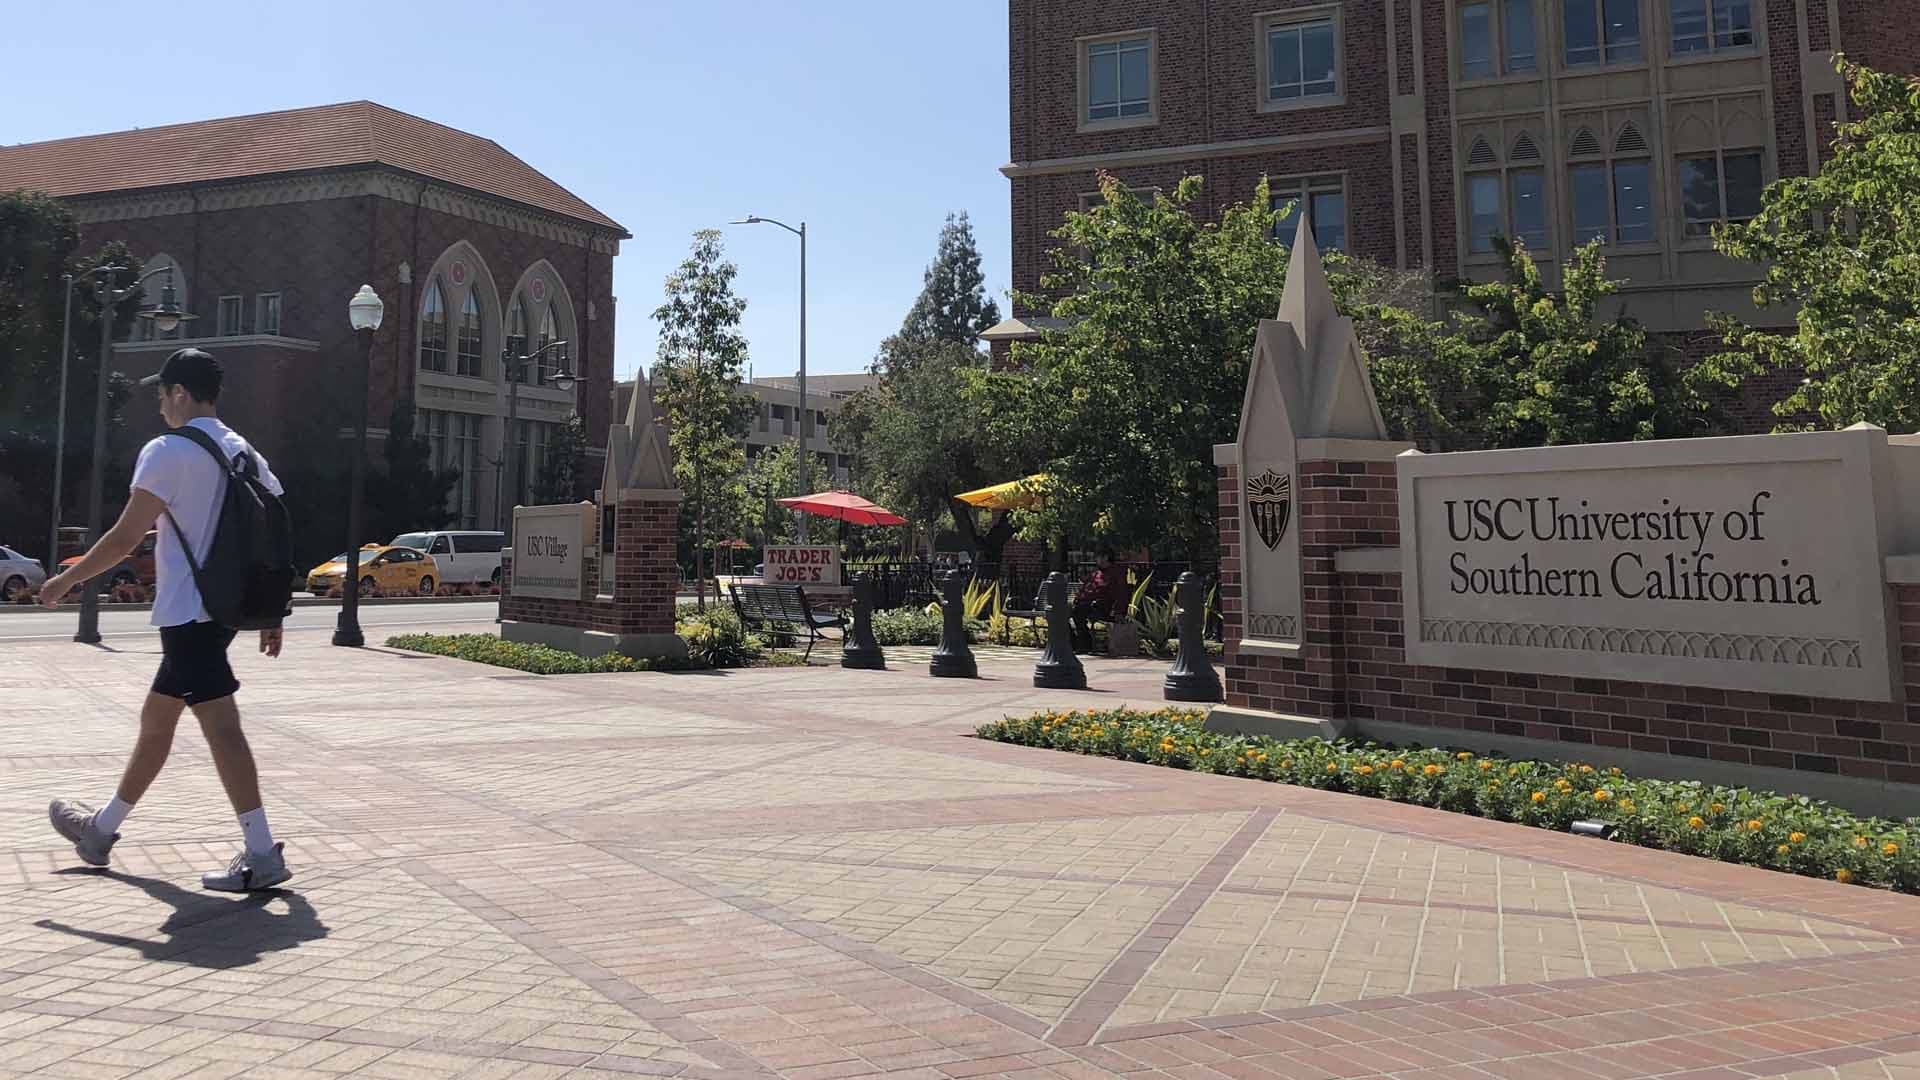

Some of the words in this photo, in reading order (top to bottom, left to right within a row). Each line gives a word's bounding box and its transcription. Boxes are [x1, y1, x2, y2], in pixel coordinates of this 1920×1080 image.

[1444, 497, 1524, 542] USC
[1527, 496, 1714, 556] University
[1722, 491, 1770, 542] of
[527, 535, 544, 557] USC
[544, 535, 568, 564] Village
[767, 549, 831, 564] TRADER
[775, 566, 822, 582] JOE'S
[1449, 551, 1602, 598] Southern
[1610, 551, 1822, 605] California
